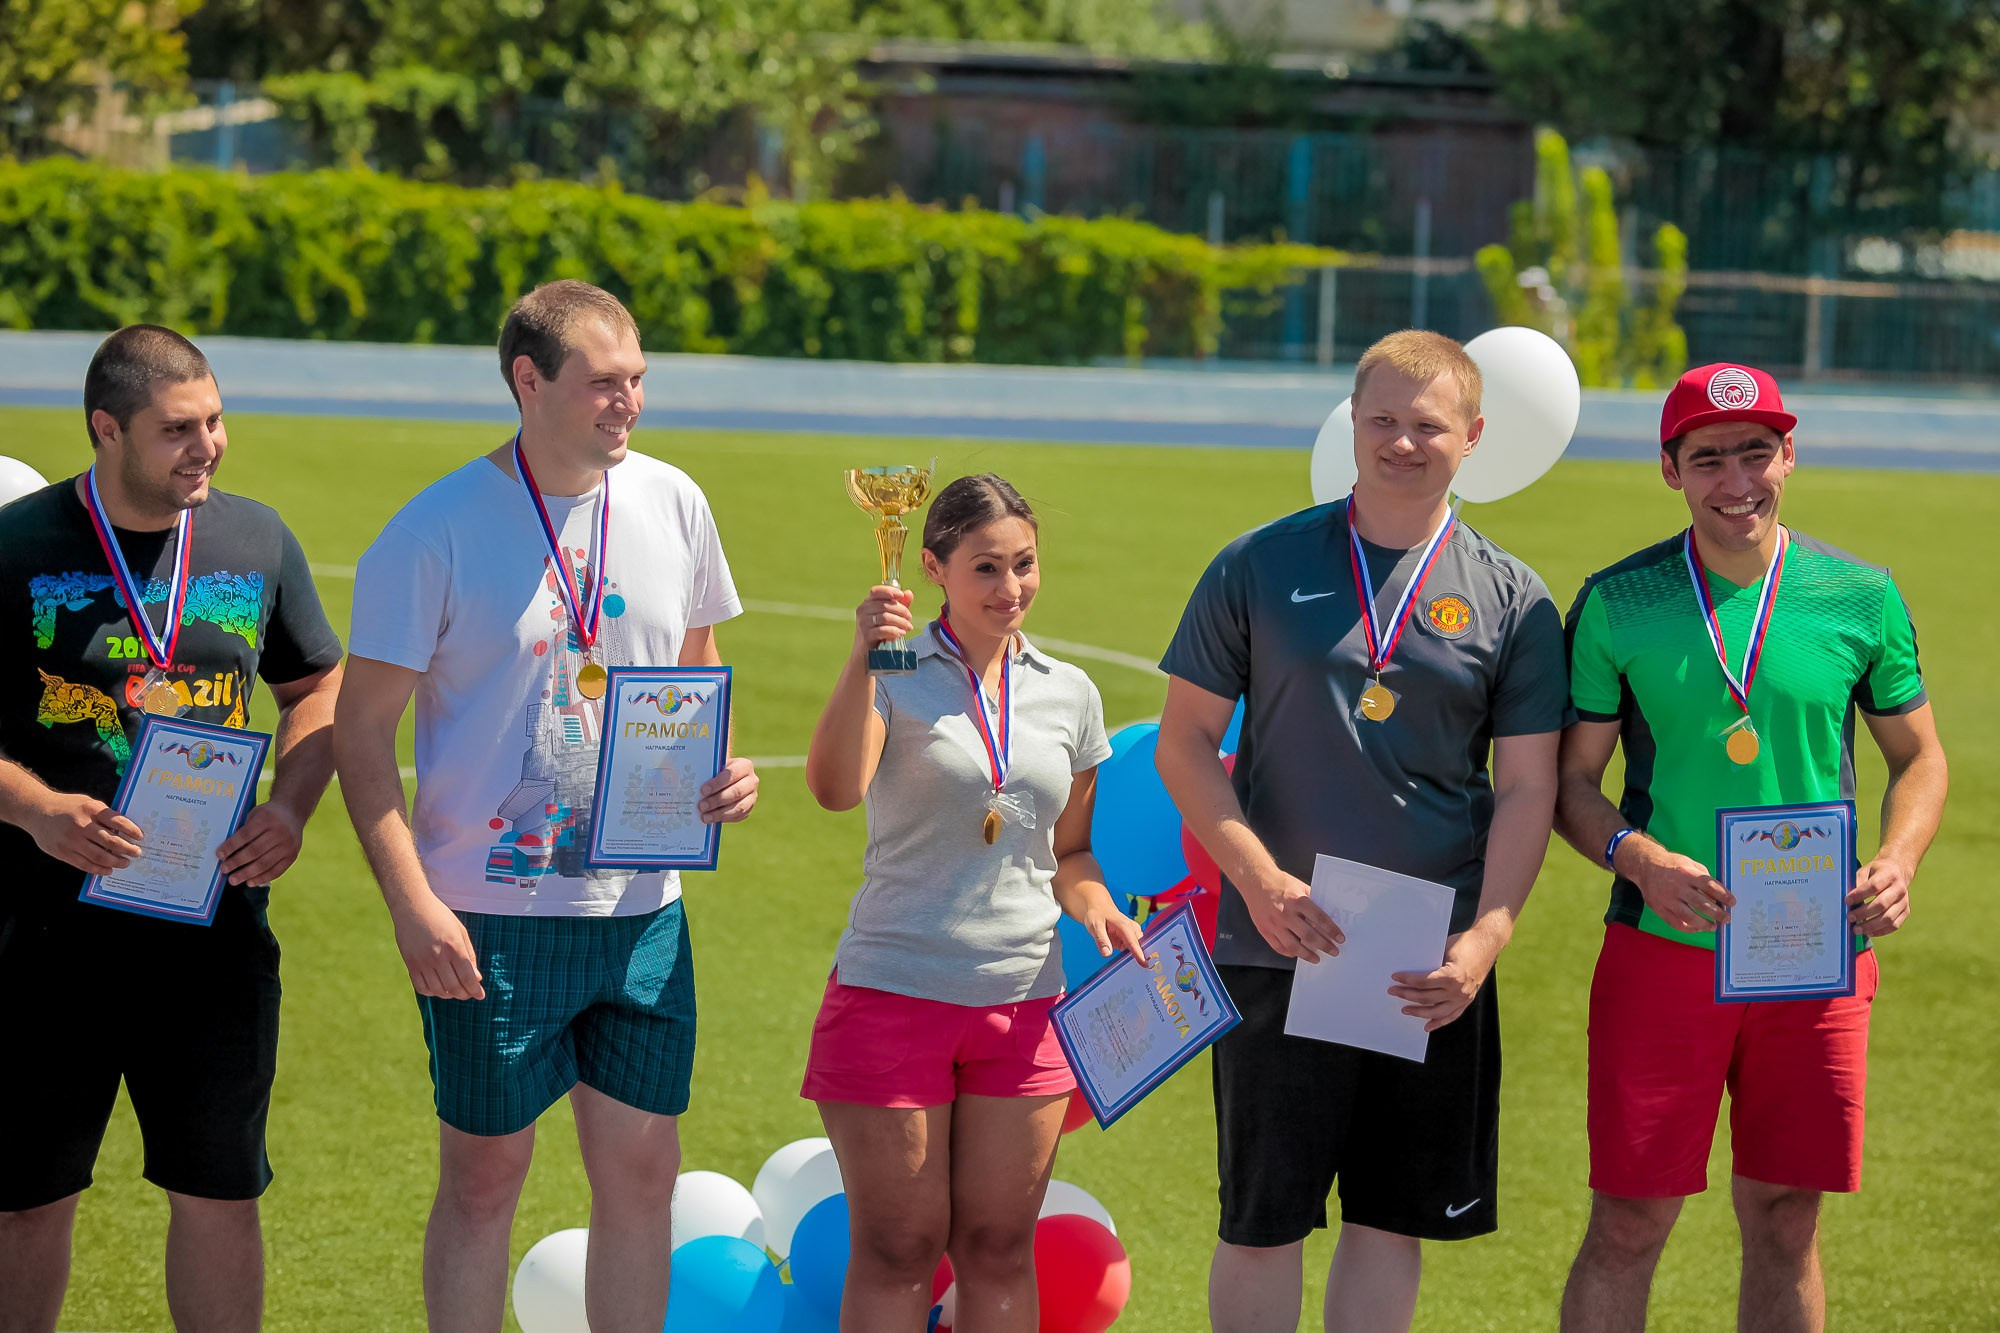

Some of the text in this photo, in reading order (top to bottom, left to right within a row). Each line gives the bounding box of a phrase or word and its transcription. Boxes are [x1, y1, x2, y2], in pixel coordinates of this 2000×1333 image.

[1433, 598, 1467, 614] MANCHESTER
[1437, 622, 1461, 631] UNITED
[106, 636, 160, 659] 201
[127, 663, 147, 673] FIFA
[177, 663, 196, 675] Cup
[624, 722, 711, 739] ГРАМОТА
[147, 768, 235, 799] ГРАМОТА
[165, 794, 207, 806] НАГРАЖДАЕТСЯ
[1740, 854, 1836, 876] ГРАМОТА
[1764, 878, 1809, 886] НАГРАЖДАЕТСЯ
[1145, 983, 1166, 1023] НАГРАЖДАЕТСЯ
[1149, 951, 1191, 1039] ГРАМОТА
